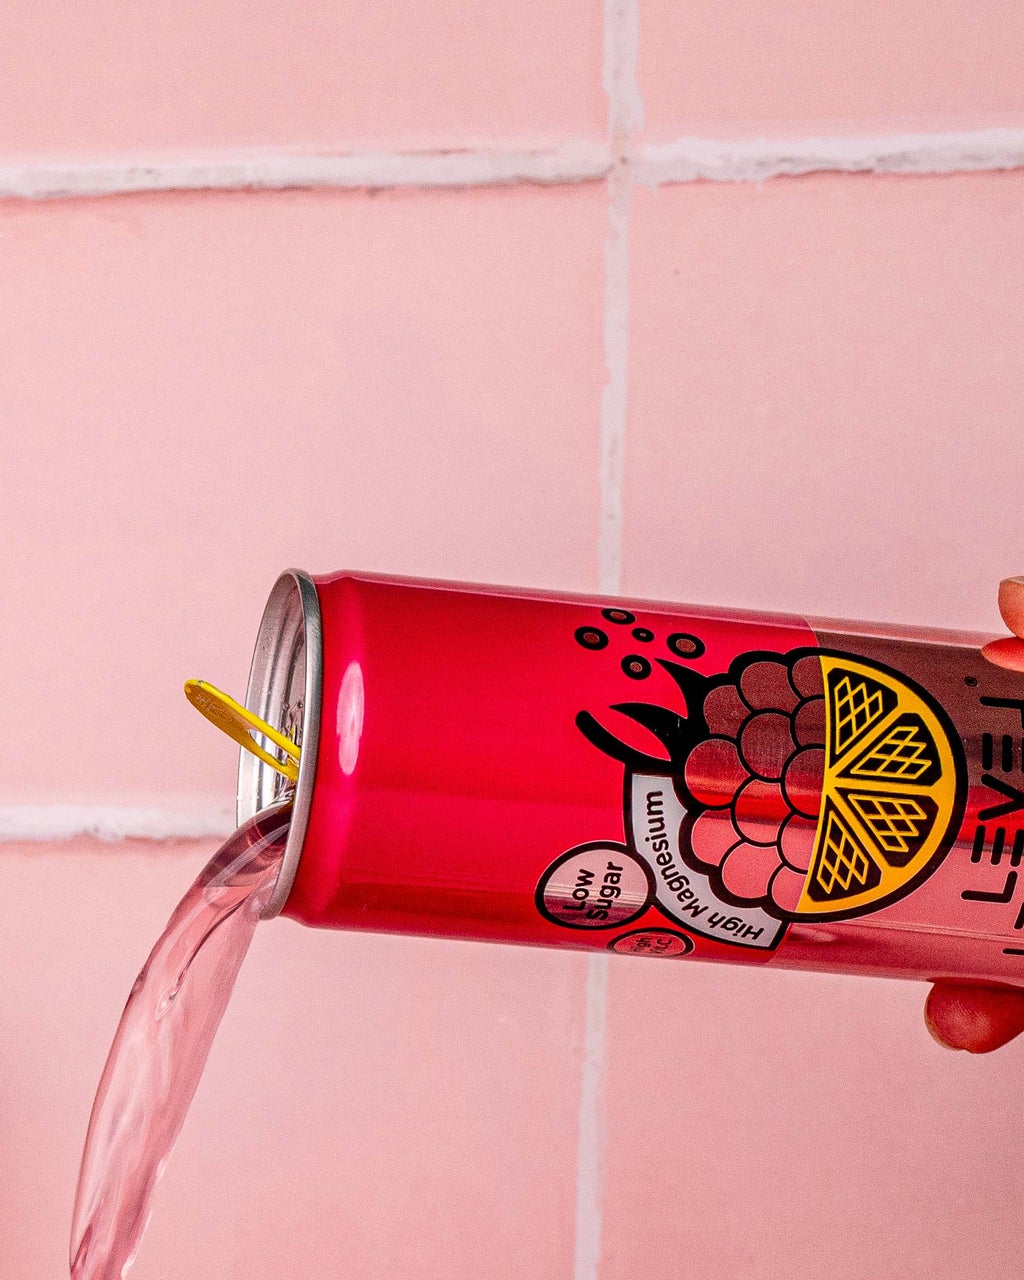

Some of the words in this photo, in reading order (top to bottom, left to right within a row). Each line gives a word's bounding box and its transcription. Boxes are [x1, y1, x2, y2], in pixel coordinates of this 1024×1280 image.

[644, 790, 702, 918] Magnesium
[563, 868, 595, 910] Low
[586, 861, 624, 920] Sugar
[707, 911, 764, 940] High
